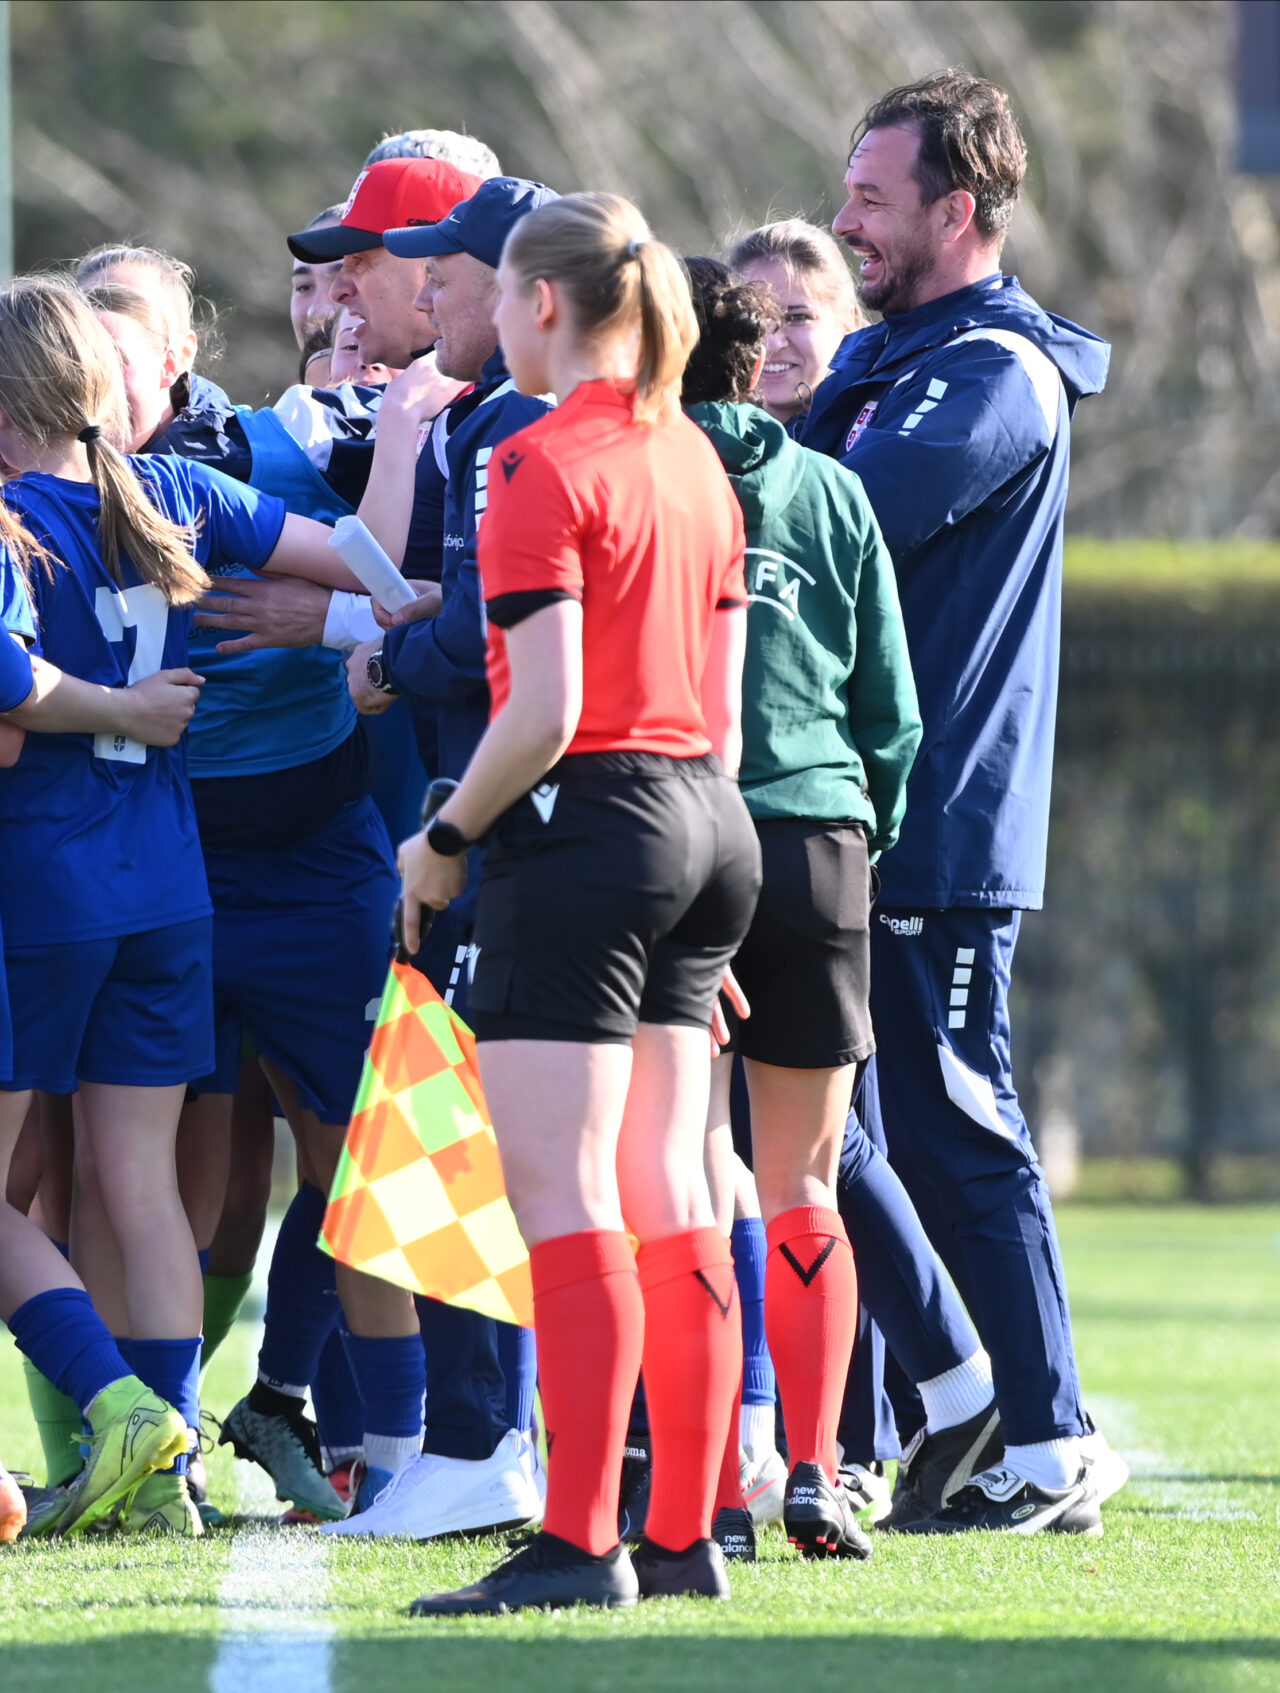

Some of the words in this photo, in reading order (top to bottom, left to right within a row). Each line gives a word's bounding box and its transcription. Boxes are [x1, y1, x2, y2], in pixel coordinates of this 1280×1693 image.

[755, 560, 801, 614] FA
[94, 583, 169, 765] 7
[793, 1486, 817, 1495] new
[786, 1494, 821, 1506] alanc
[724, 1534, 747, 1543] new
[721, 1542, 753, 1553] alanc
